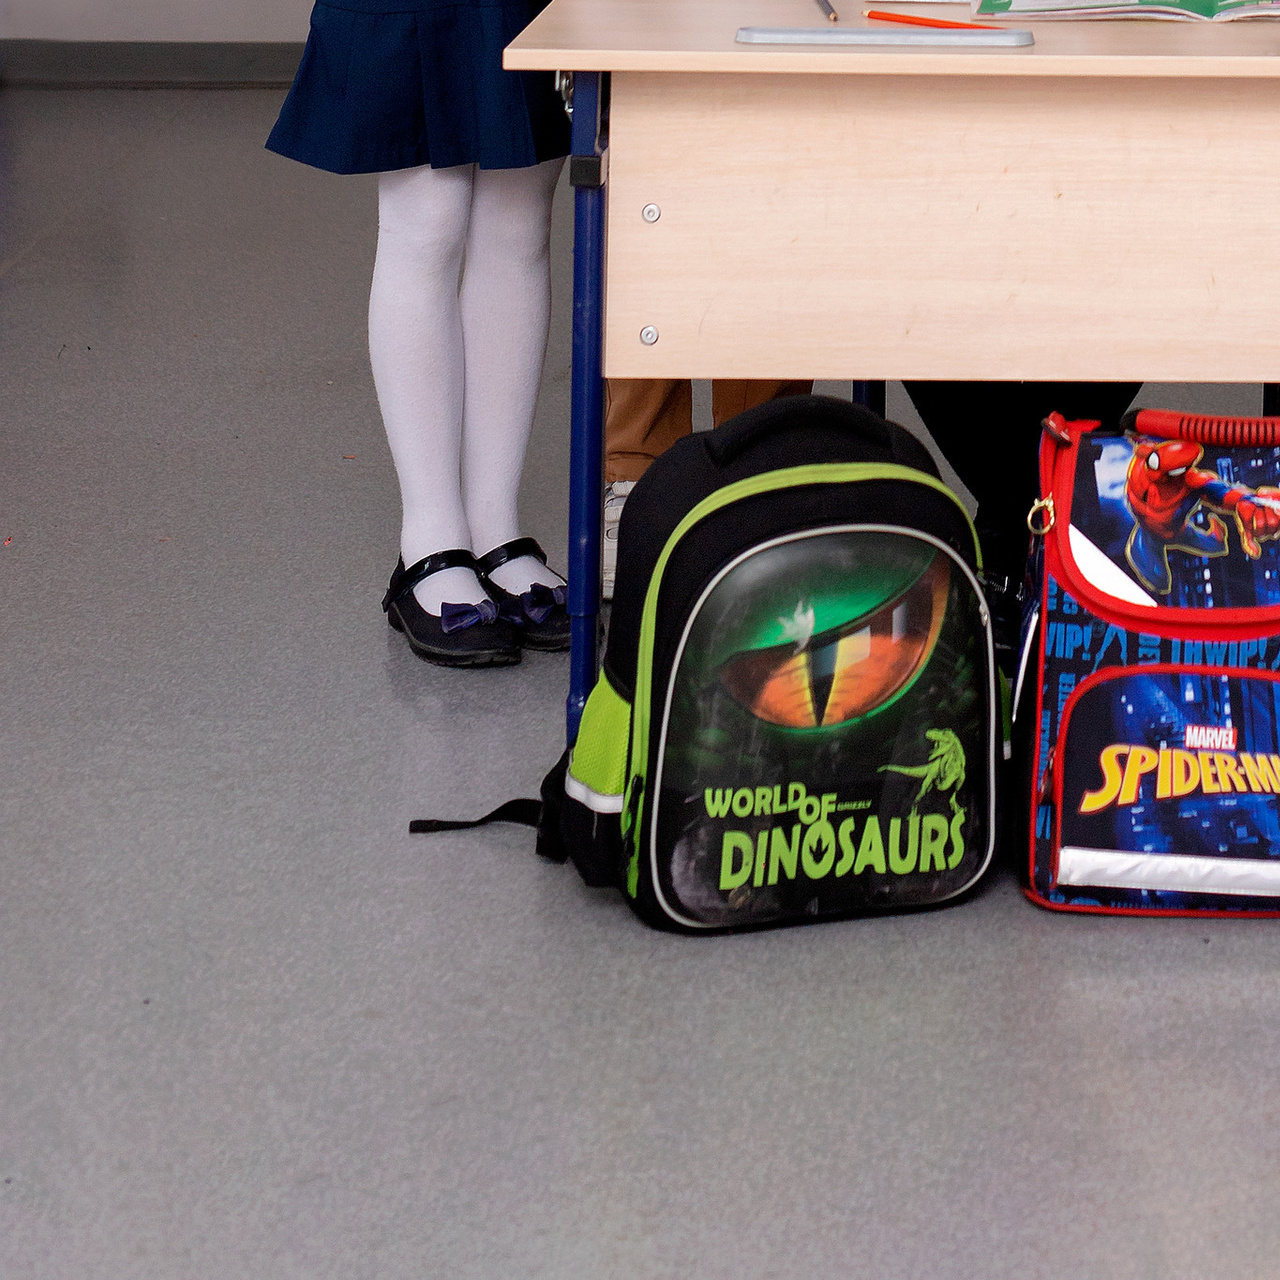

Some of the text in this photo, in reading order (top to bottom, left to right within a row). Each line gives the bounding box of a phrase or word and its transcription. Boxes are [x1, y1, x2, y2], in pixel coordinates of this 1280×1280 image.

[1185, 725, 1236, 750] MARVEL
[704, 782, 838, 825] WORLD OF
[718, 811, 966, 890] DINOSAURS
